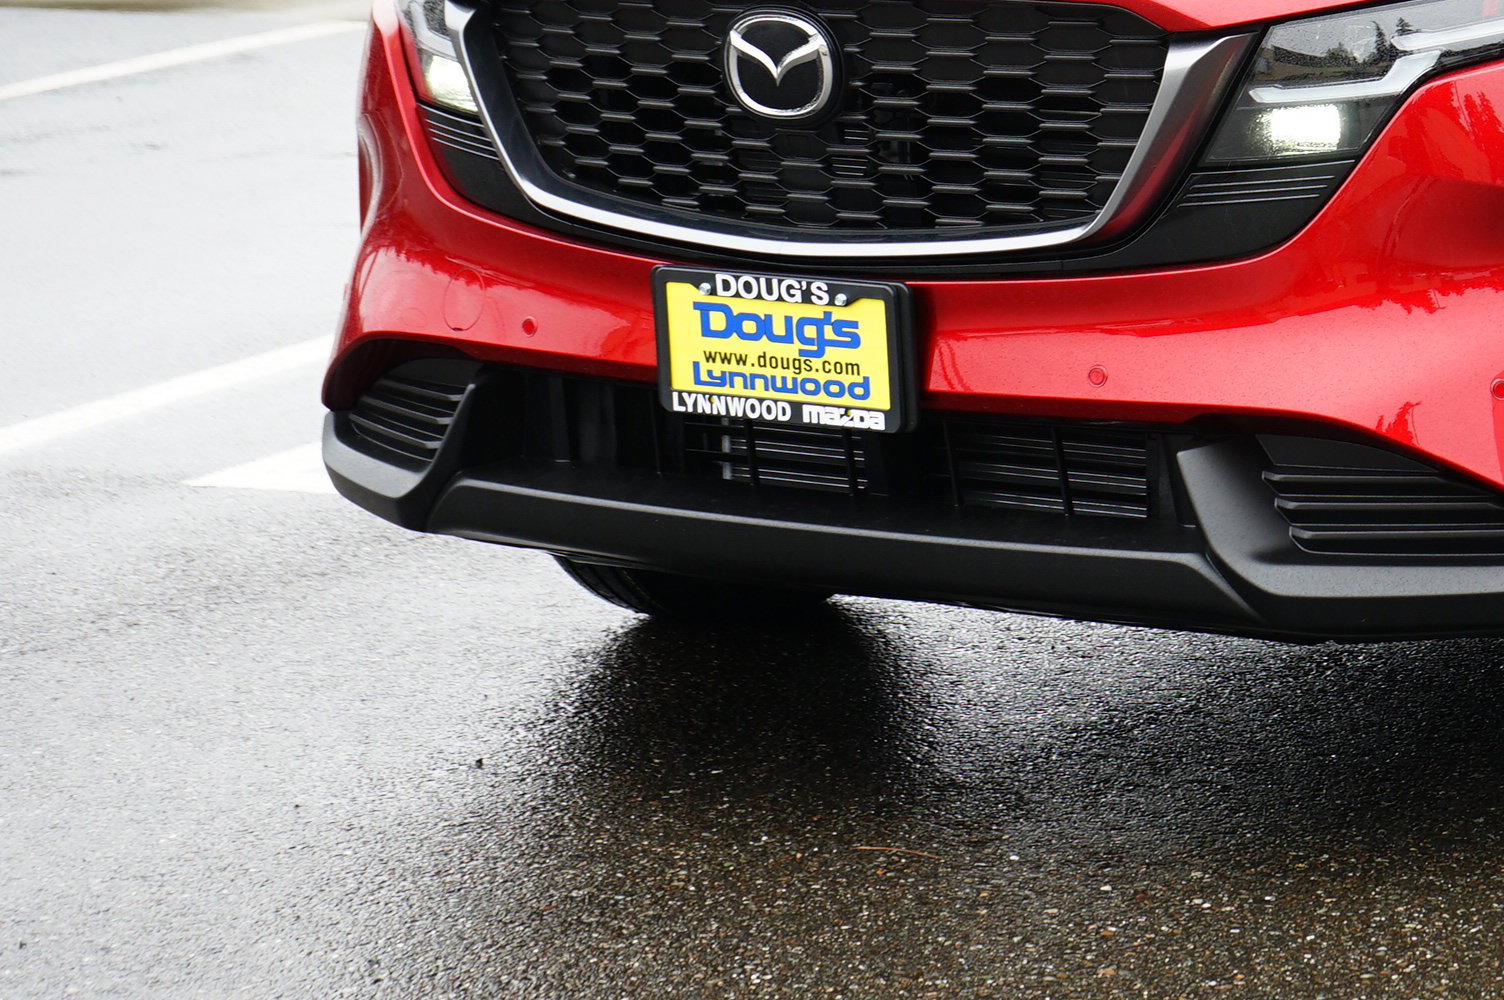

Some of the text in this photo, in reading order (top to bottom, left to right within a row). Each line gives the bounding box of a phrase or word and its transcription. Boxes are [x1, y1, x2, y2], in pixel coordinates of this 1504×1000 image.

[714, 273, 830, 306] DOUG'S
[692, 301, 862, 358] Doug's
[703, 350, 861, 376] www.dougs.com
[692, 361, 871, 401] Lynnwood
[672, 391, 792, 422] LYNNWOOD
